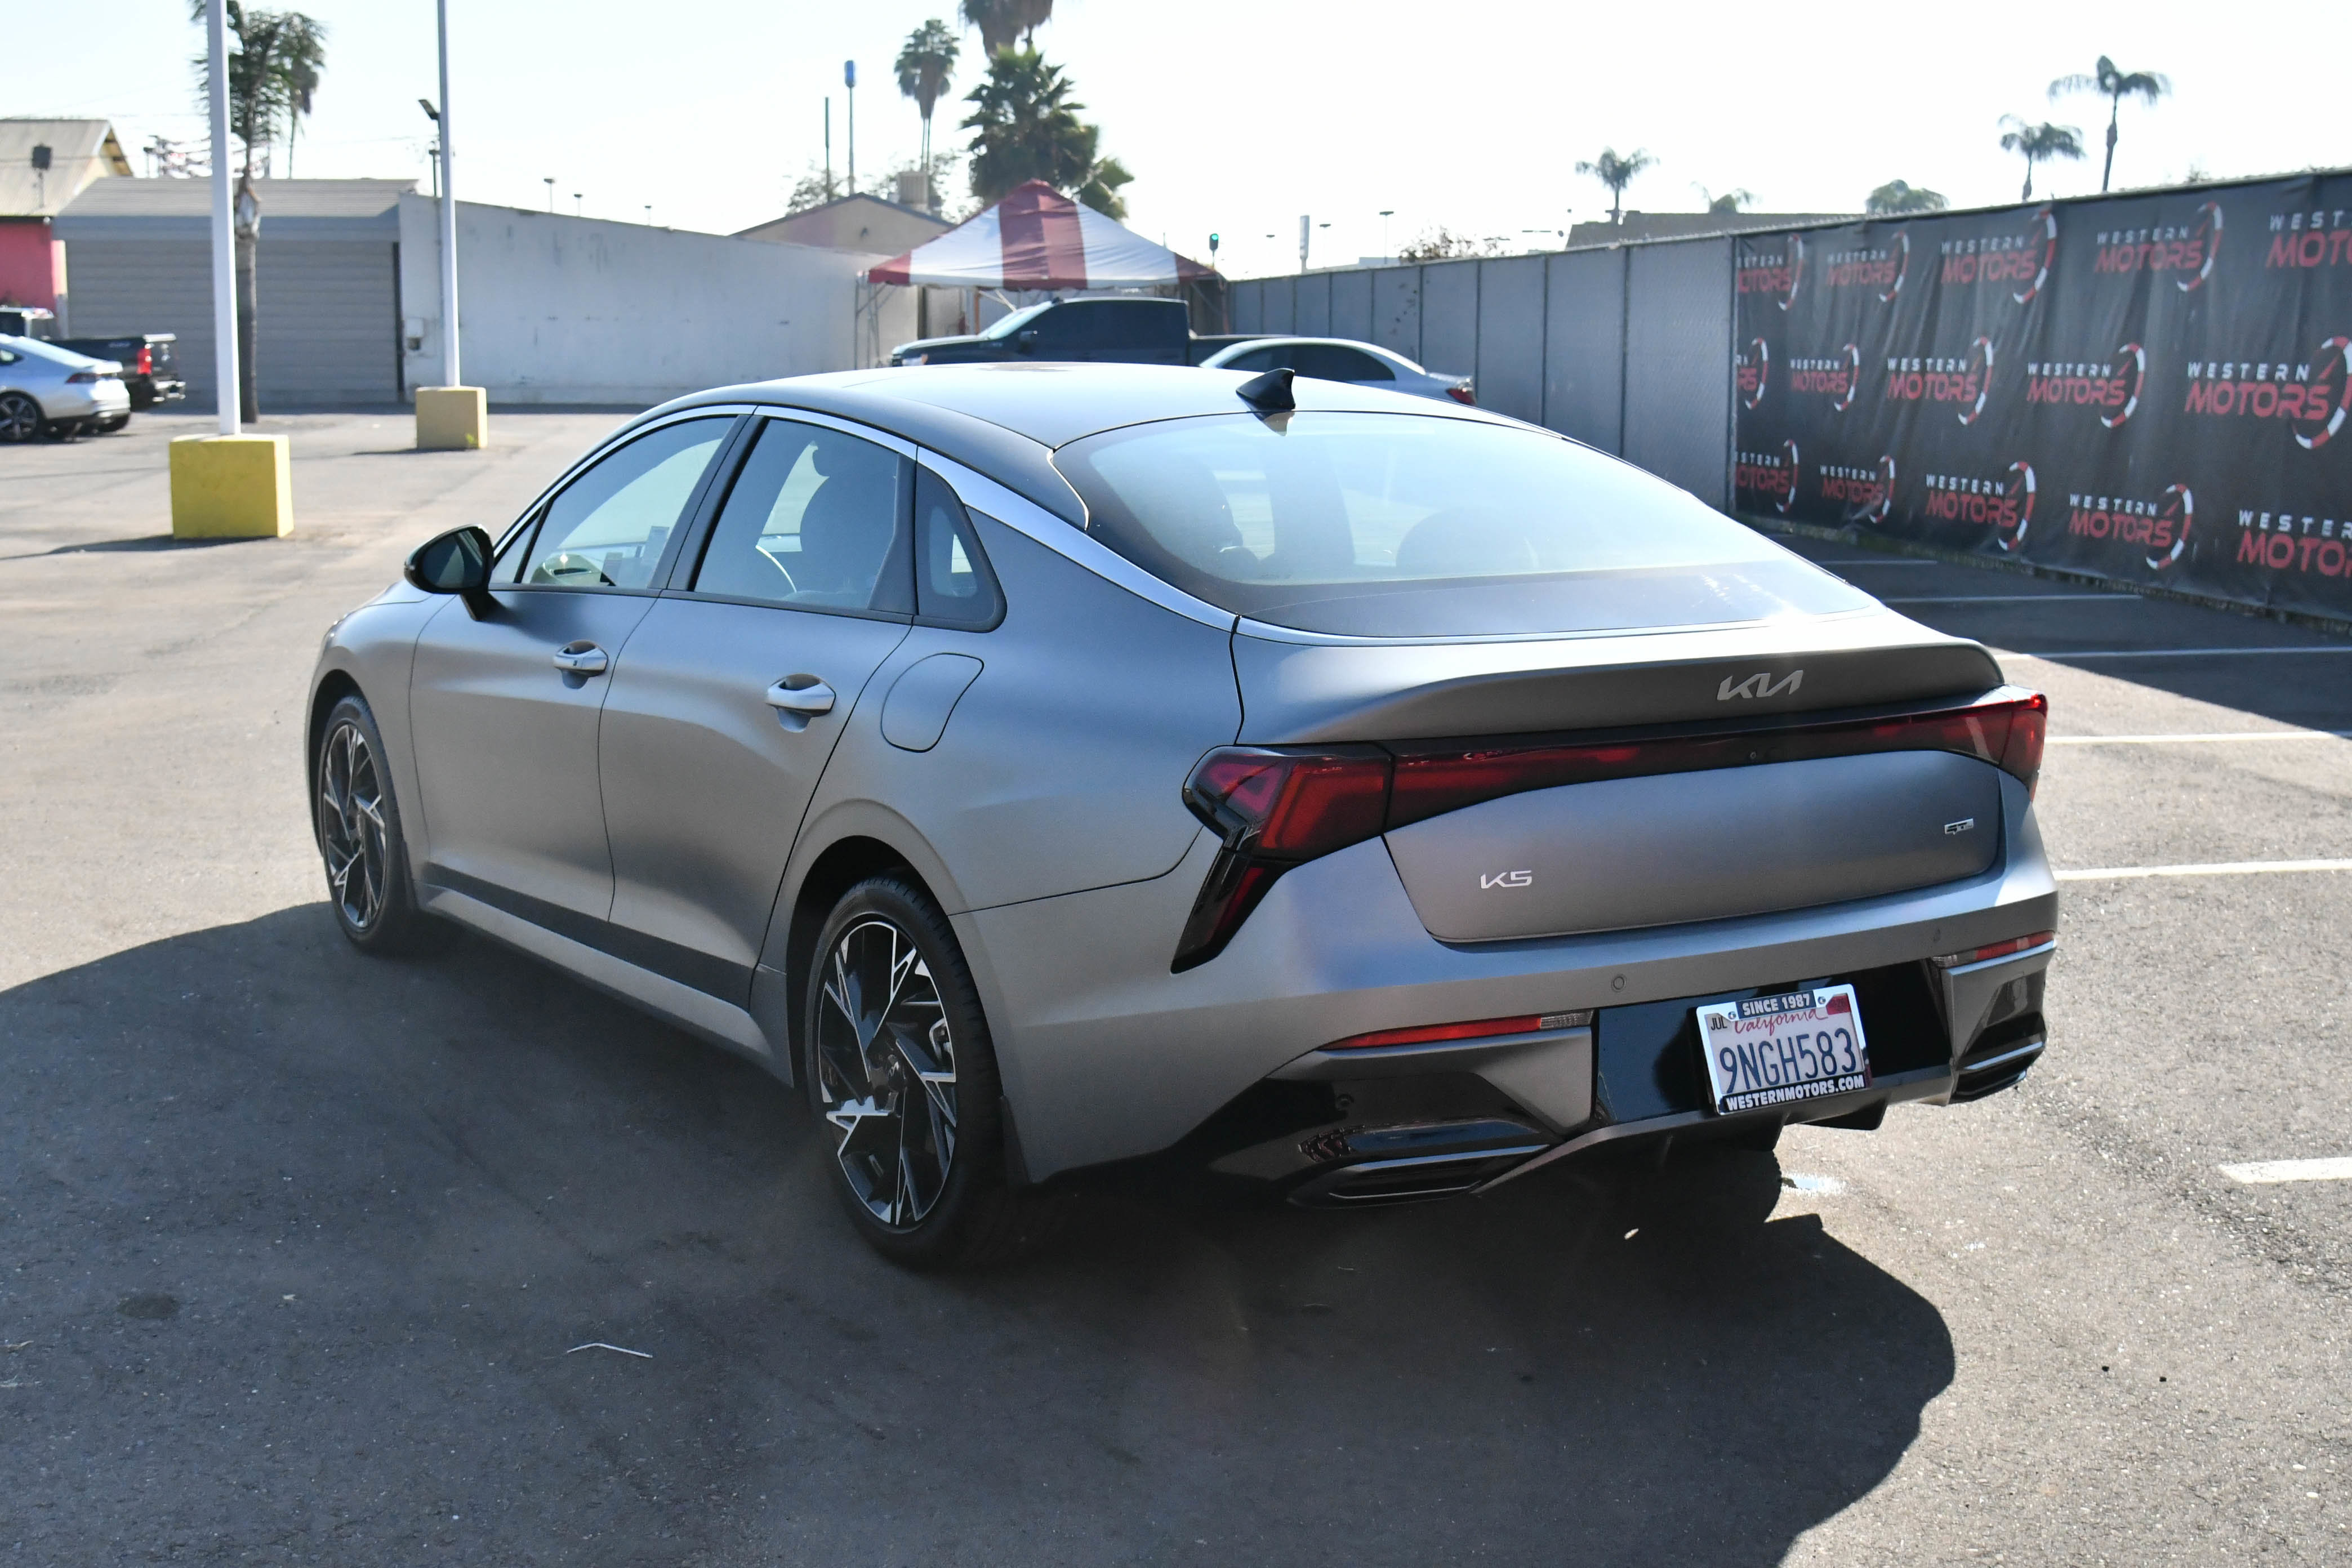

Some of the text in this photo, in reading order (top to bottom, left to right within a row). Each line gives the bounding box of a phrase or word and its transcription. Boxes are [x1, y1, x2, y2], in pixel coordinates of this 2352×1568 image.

[1941, 235, 2024, 254] WESTERN
[2096, 226, 2189, 244] WESTERN
[1828, 250, 1886, 263] WESTERN
[2093, 240, 2204, 274] MOTORS
[2265, 230, 2352, 268] MOT
[1827, 261, 1896, 286] MOTORS
[1941, 250, 2037, 284] MOTORS
[1790, 359, 1839, 370] WESTERN
[1888, 356, 1967, 372] WESTERN
[2027, 362, 2111, 377] WESTERN
[2188, 361, 2310, 381] WESTERN
[1791, 371, 1848, 393] MOTORS
[1887, 372, 1978, 402] MOTORS
[2026, 377, 2127, 406] MOTORS
[2184, 380, 2332, 420] MOTORS
[1820, 465, 1876, 481] WESTERN
[1926, 473, 2004, 496] WESTERN
[1821, 478, 1885, 505] MOTORS
[1926, 489, 2018, 528] MOTORS
[2069, 493, 2158, 517] WESTERN
[2068, 510, 2174, 547] MOTORS
[1717, 669, 1804, 700] KIA
[1480, 870, 1532, 889] K5
[1743, 994, 1810, 1015] SINCE 1987
[1710, 1017, 1727, 1031] JUL
[1734, 1009, 1828, 1036] California
[1720, 1028, 1856, 1094] 9NGH583
[1726, 1074, 1865, 1111] WESTERNMOTORS.COM
